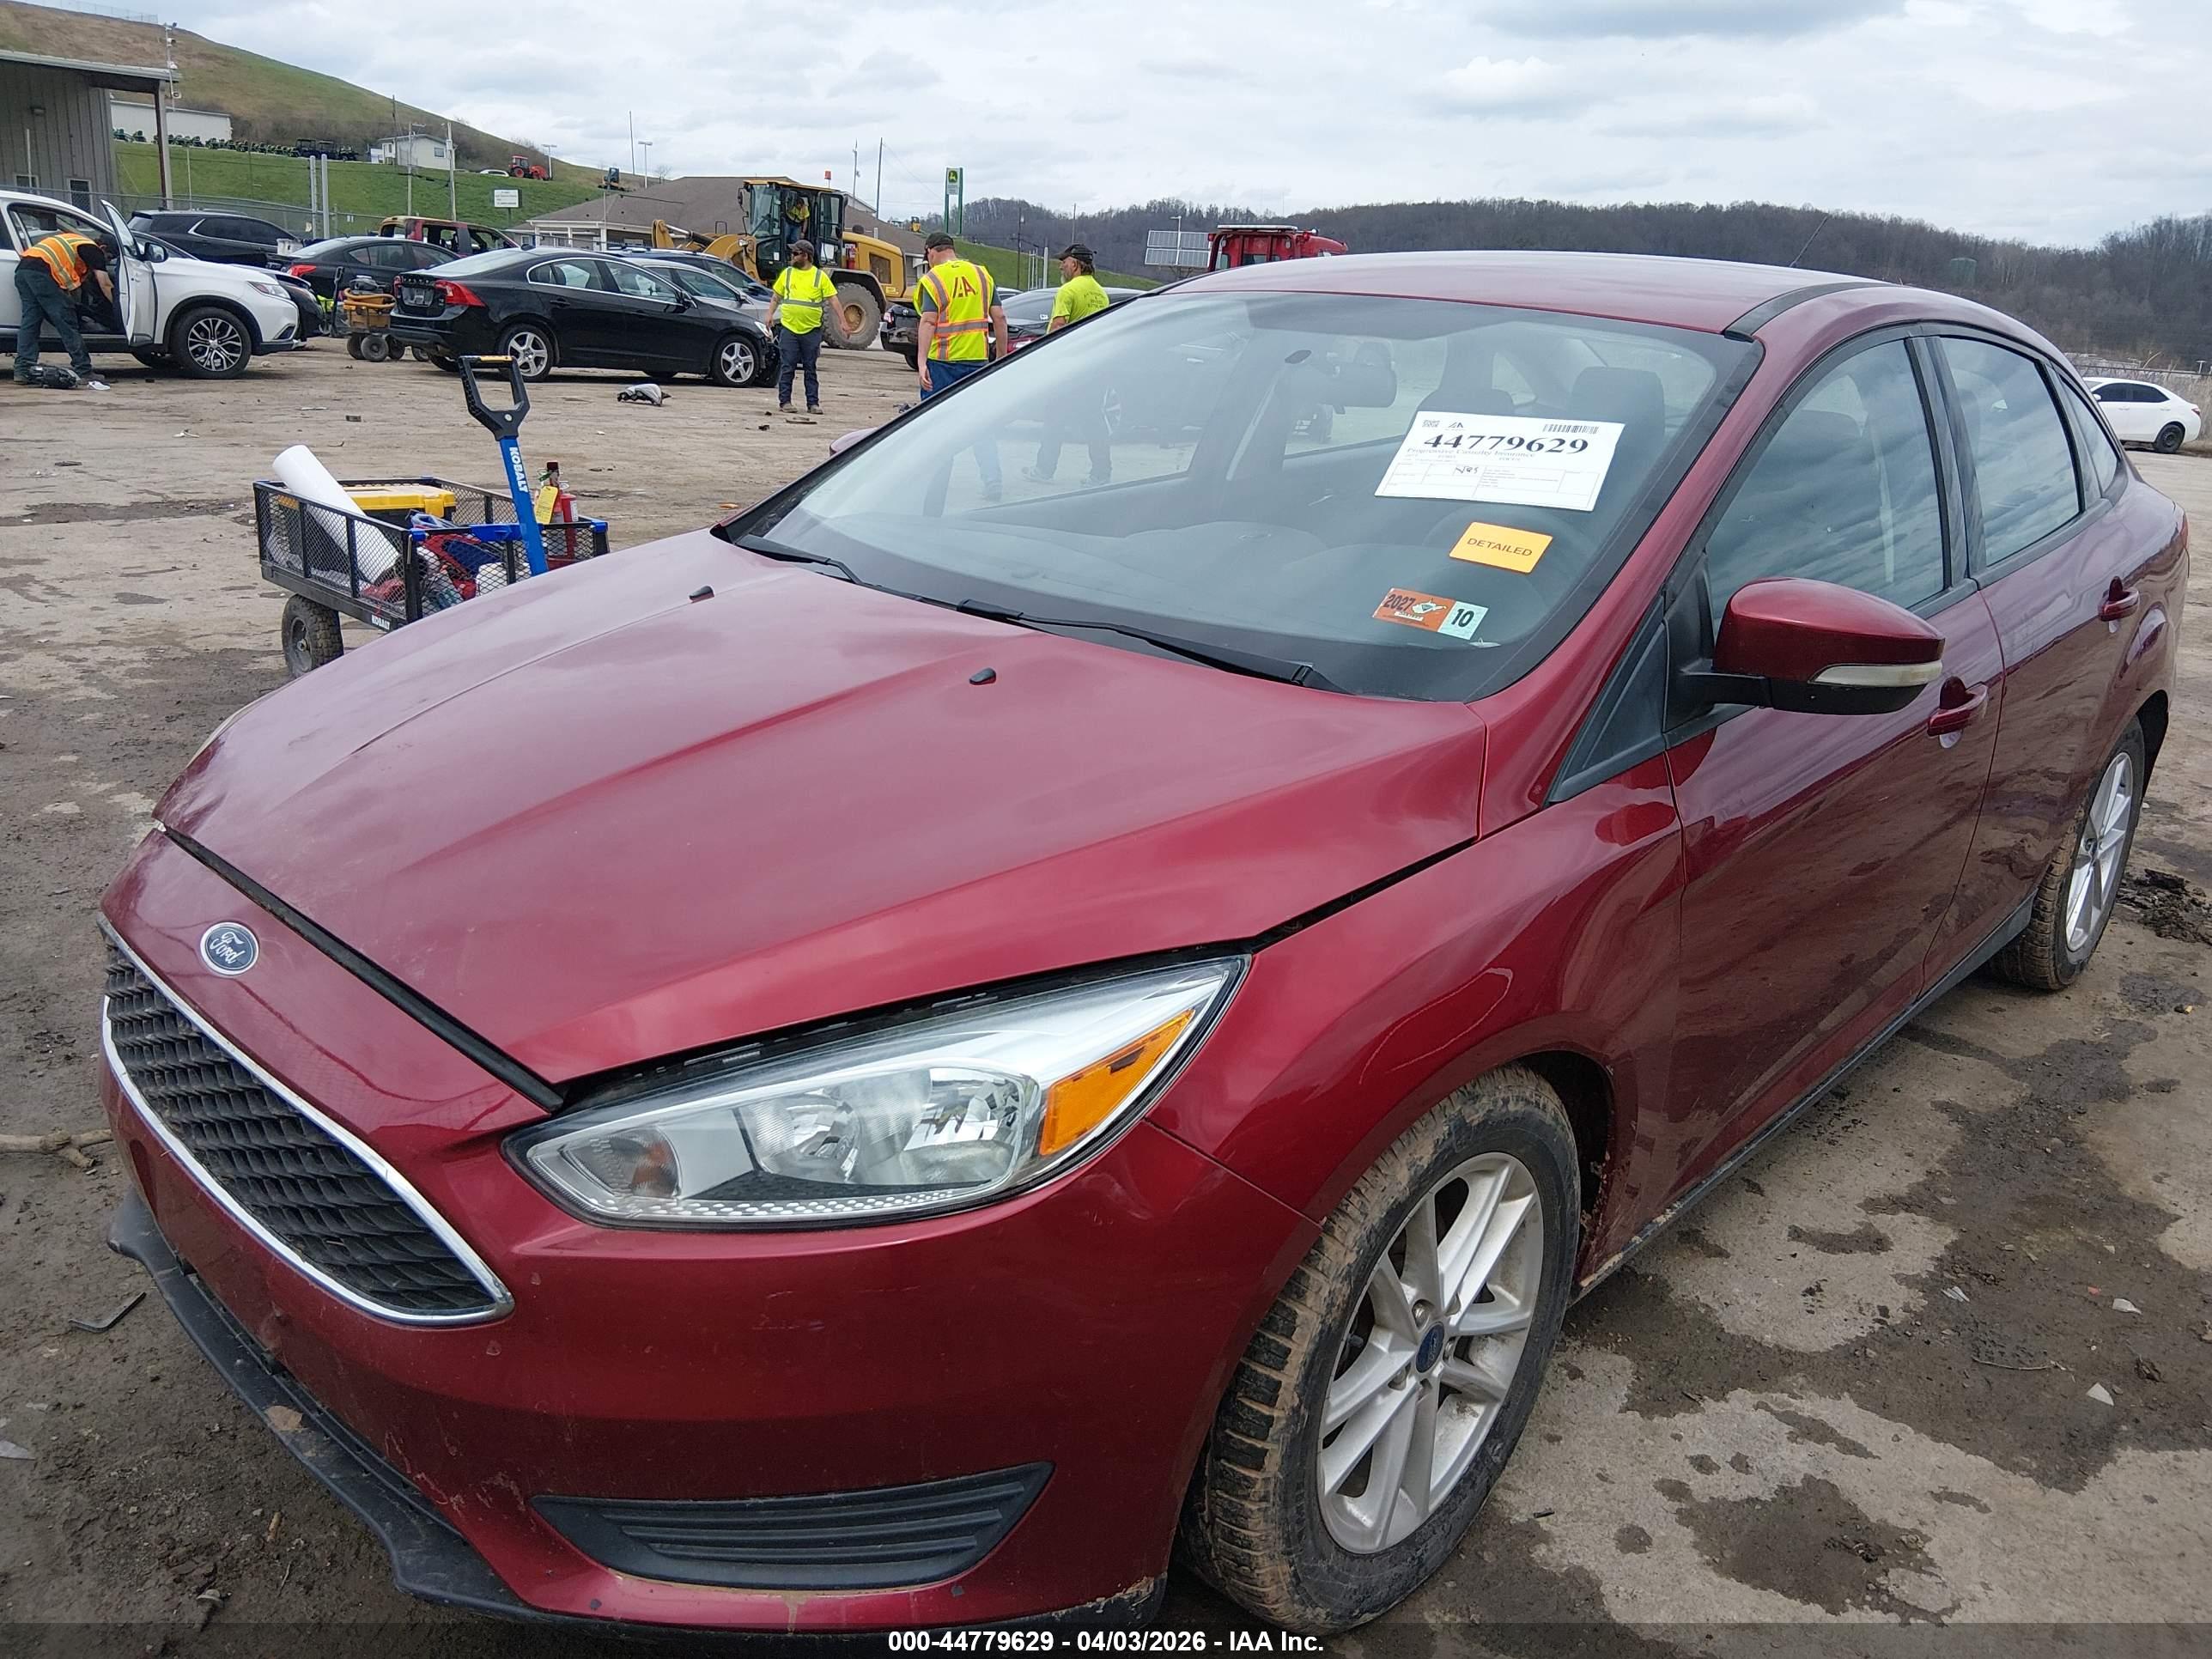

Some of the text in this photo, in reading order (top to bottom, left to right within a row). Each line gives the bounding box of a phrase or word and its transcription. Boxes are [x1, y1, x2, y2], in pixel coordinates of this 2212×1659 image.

[1424, 434, 1589, 454] 44779629
[508, 447, 529, 493] KOBALT
[1467, 538, 1533, 556] DETAILED
[1383, 593, 1416, 611] 2027
[1451, 608, 1475, 628] 10
[210, 932, 246, 964] Ford
